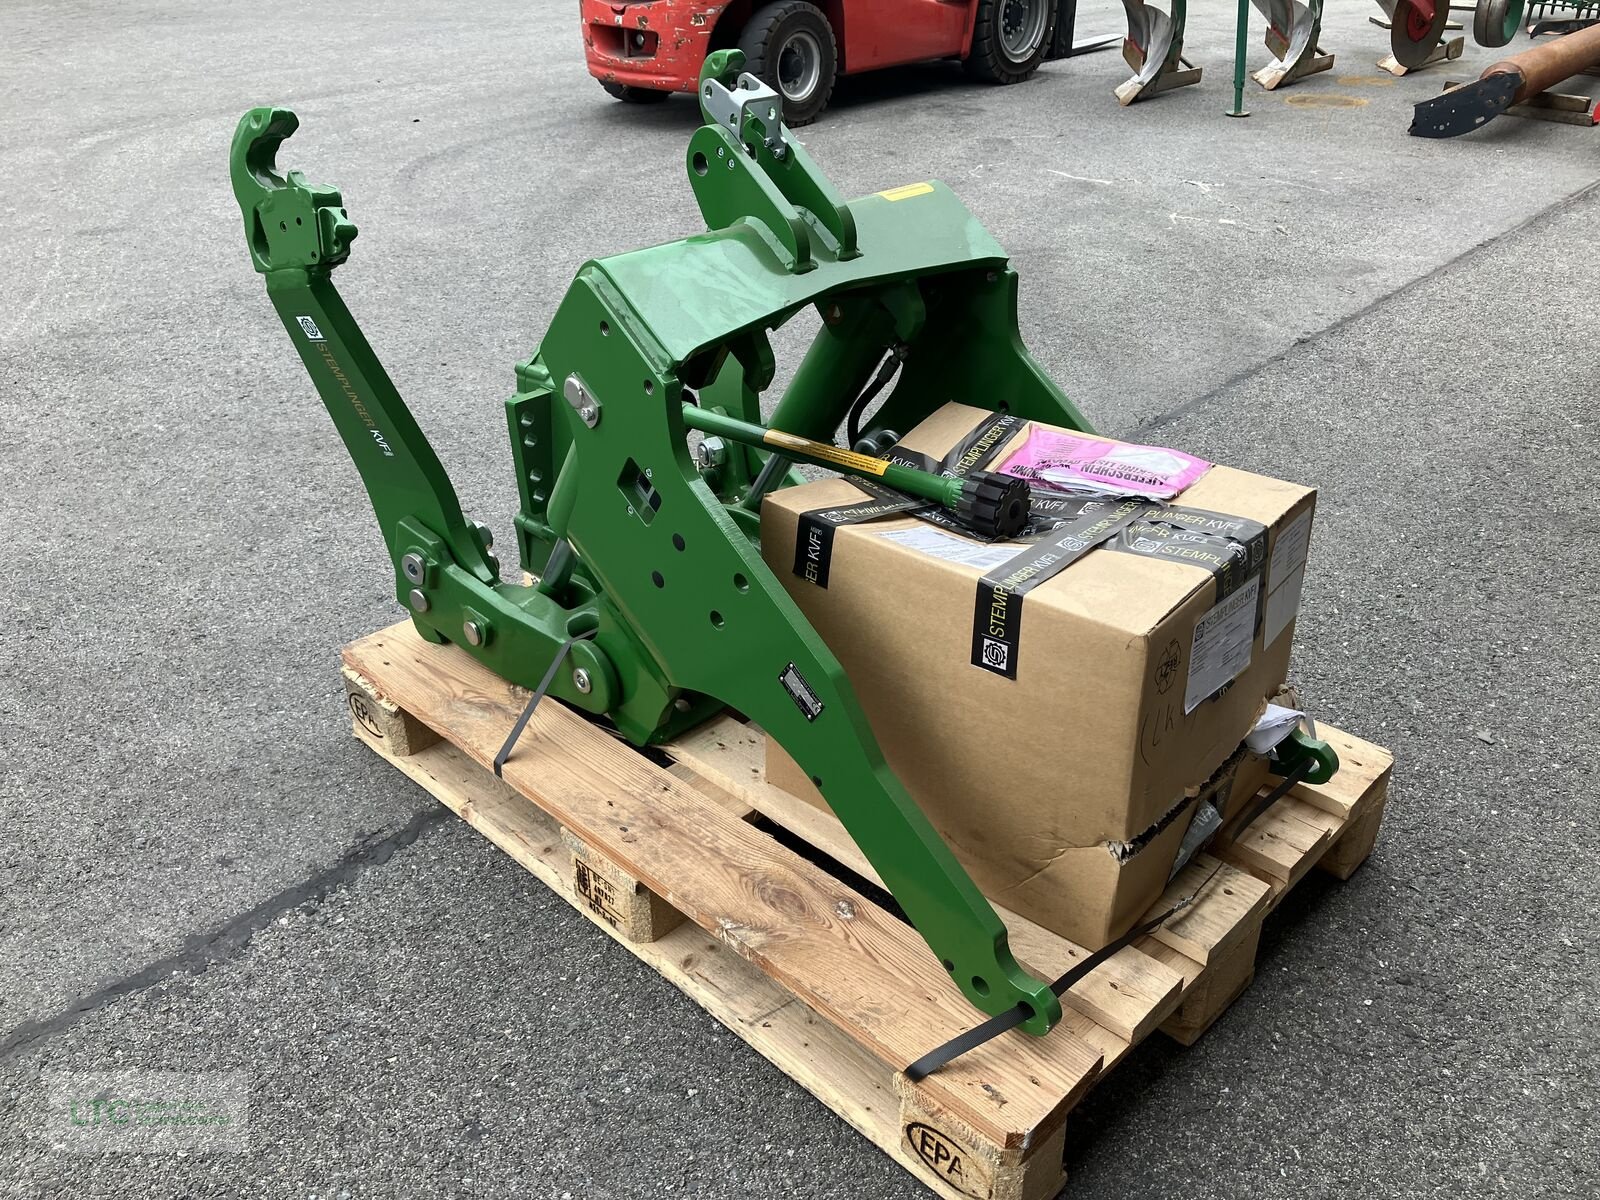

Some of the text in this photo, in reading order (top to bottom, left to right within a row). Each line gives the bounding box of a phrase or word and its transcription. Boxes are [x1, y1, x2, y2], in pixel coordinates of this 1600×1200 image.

[316, 342, 376, 428] STEMPLINGER
[952, 423, 1007, 476] STEMPLINGER
[1078, 500, 1139, 540] STEMPLINGER
[1143, 509, 1206, 525] PLINGER
[989, 566, 1040, 638] STEMPLINGER
